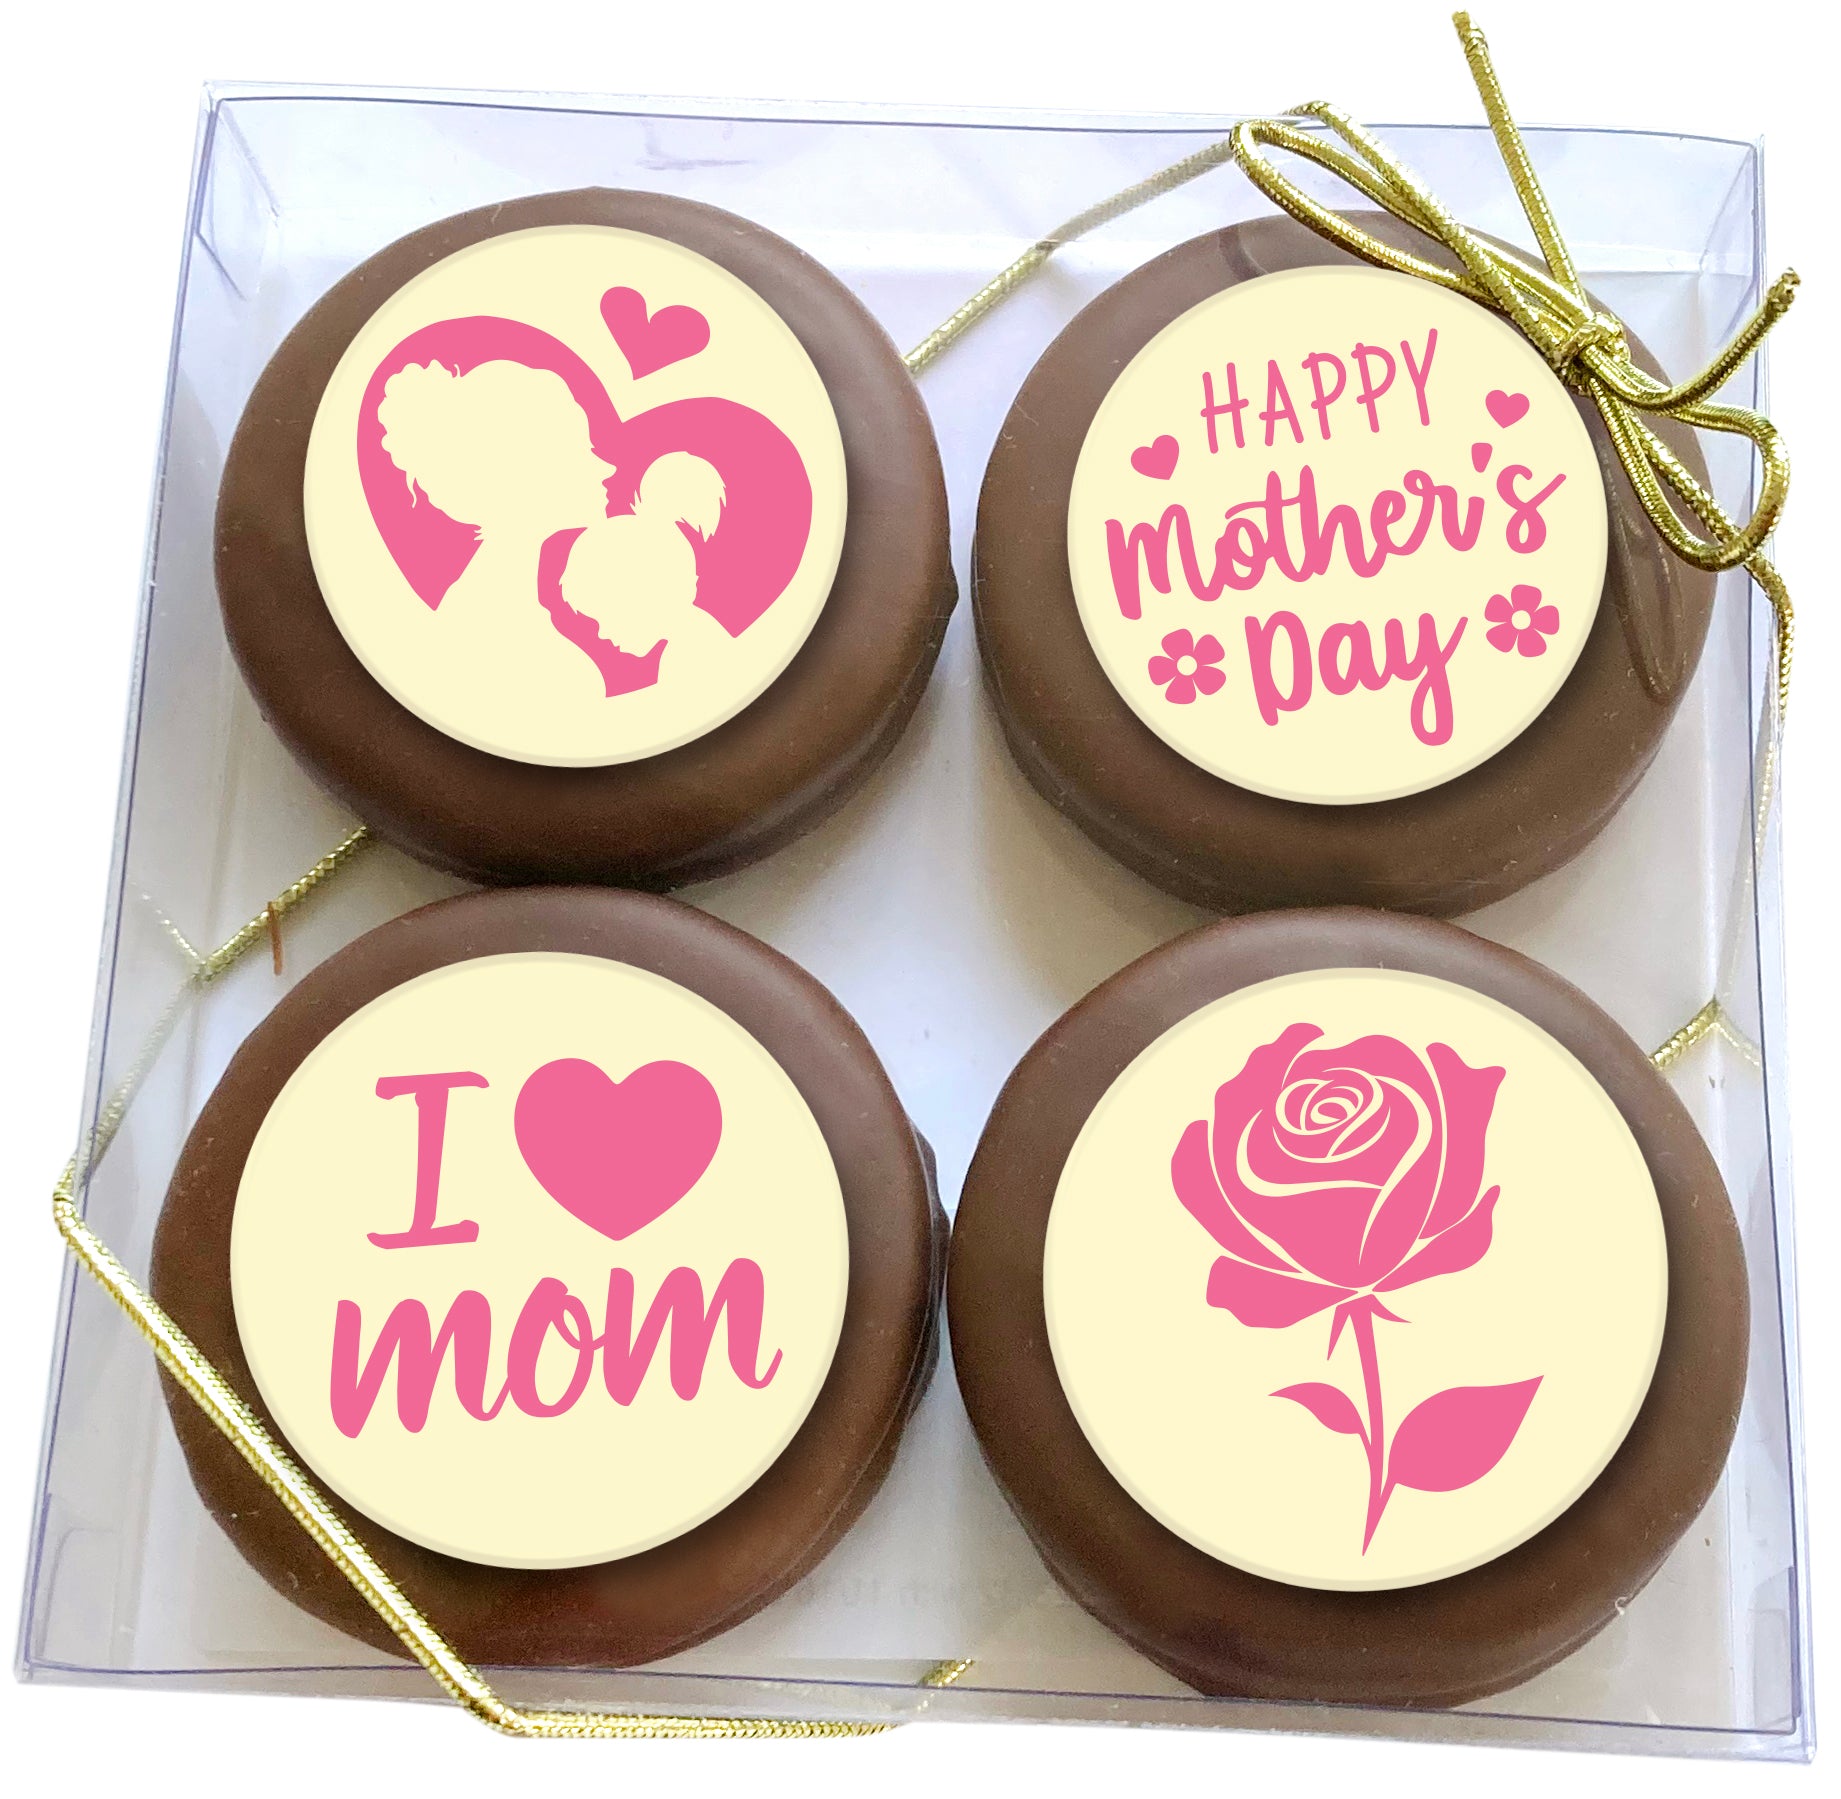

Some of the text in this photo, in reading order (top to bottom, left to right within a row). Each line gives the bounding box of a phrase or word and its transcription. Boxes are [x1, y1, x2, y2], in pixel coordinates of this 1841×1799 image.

[1201, 328, 1437, 453] HAPPY
[1245, 611, 1468, 746] Day
[367, 1072, 489, 1249] I
[330, 1258, 782, 1438] mom
